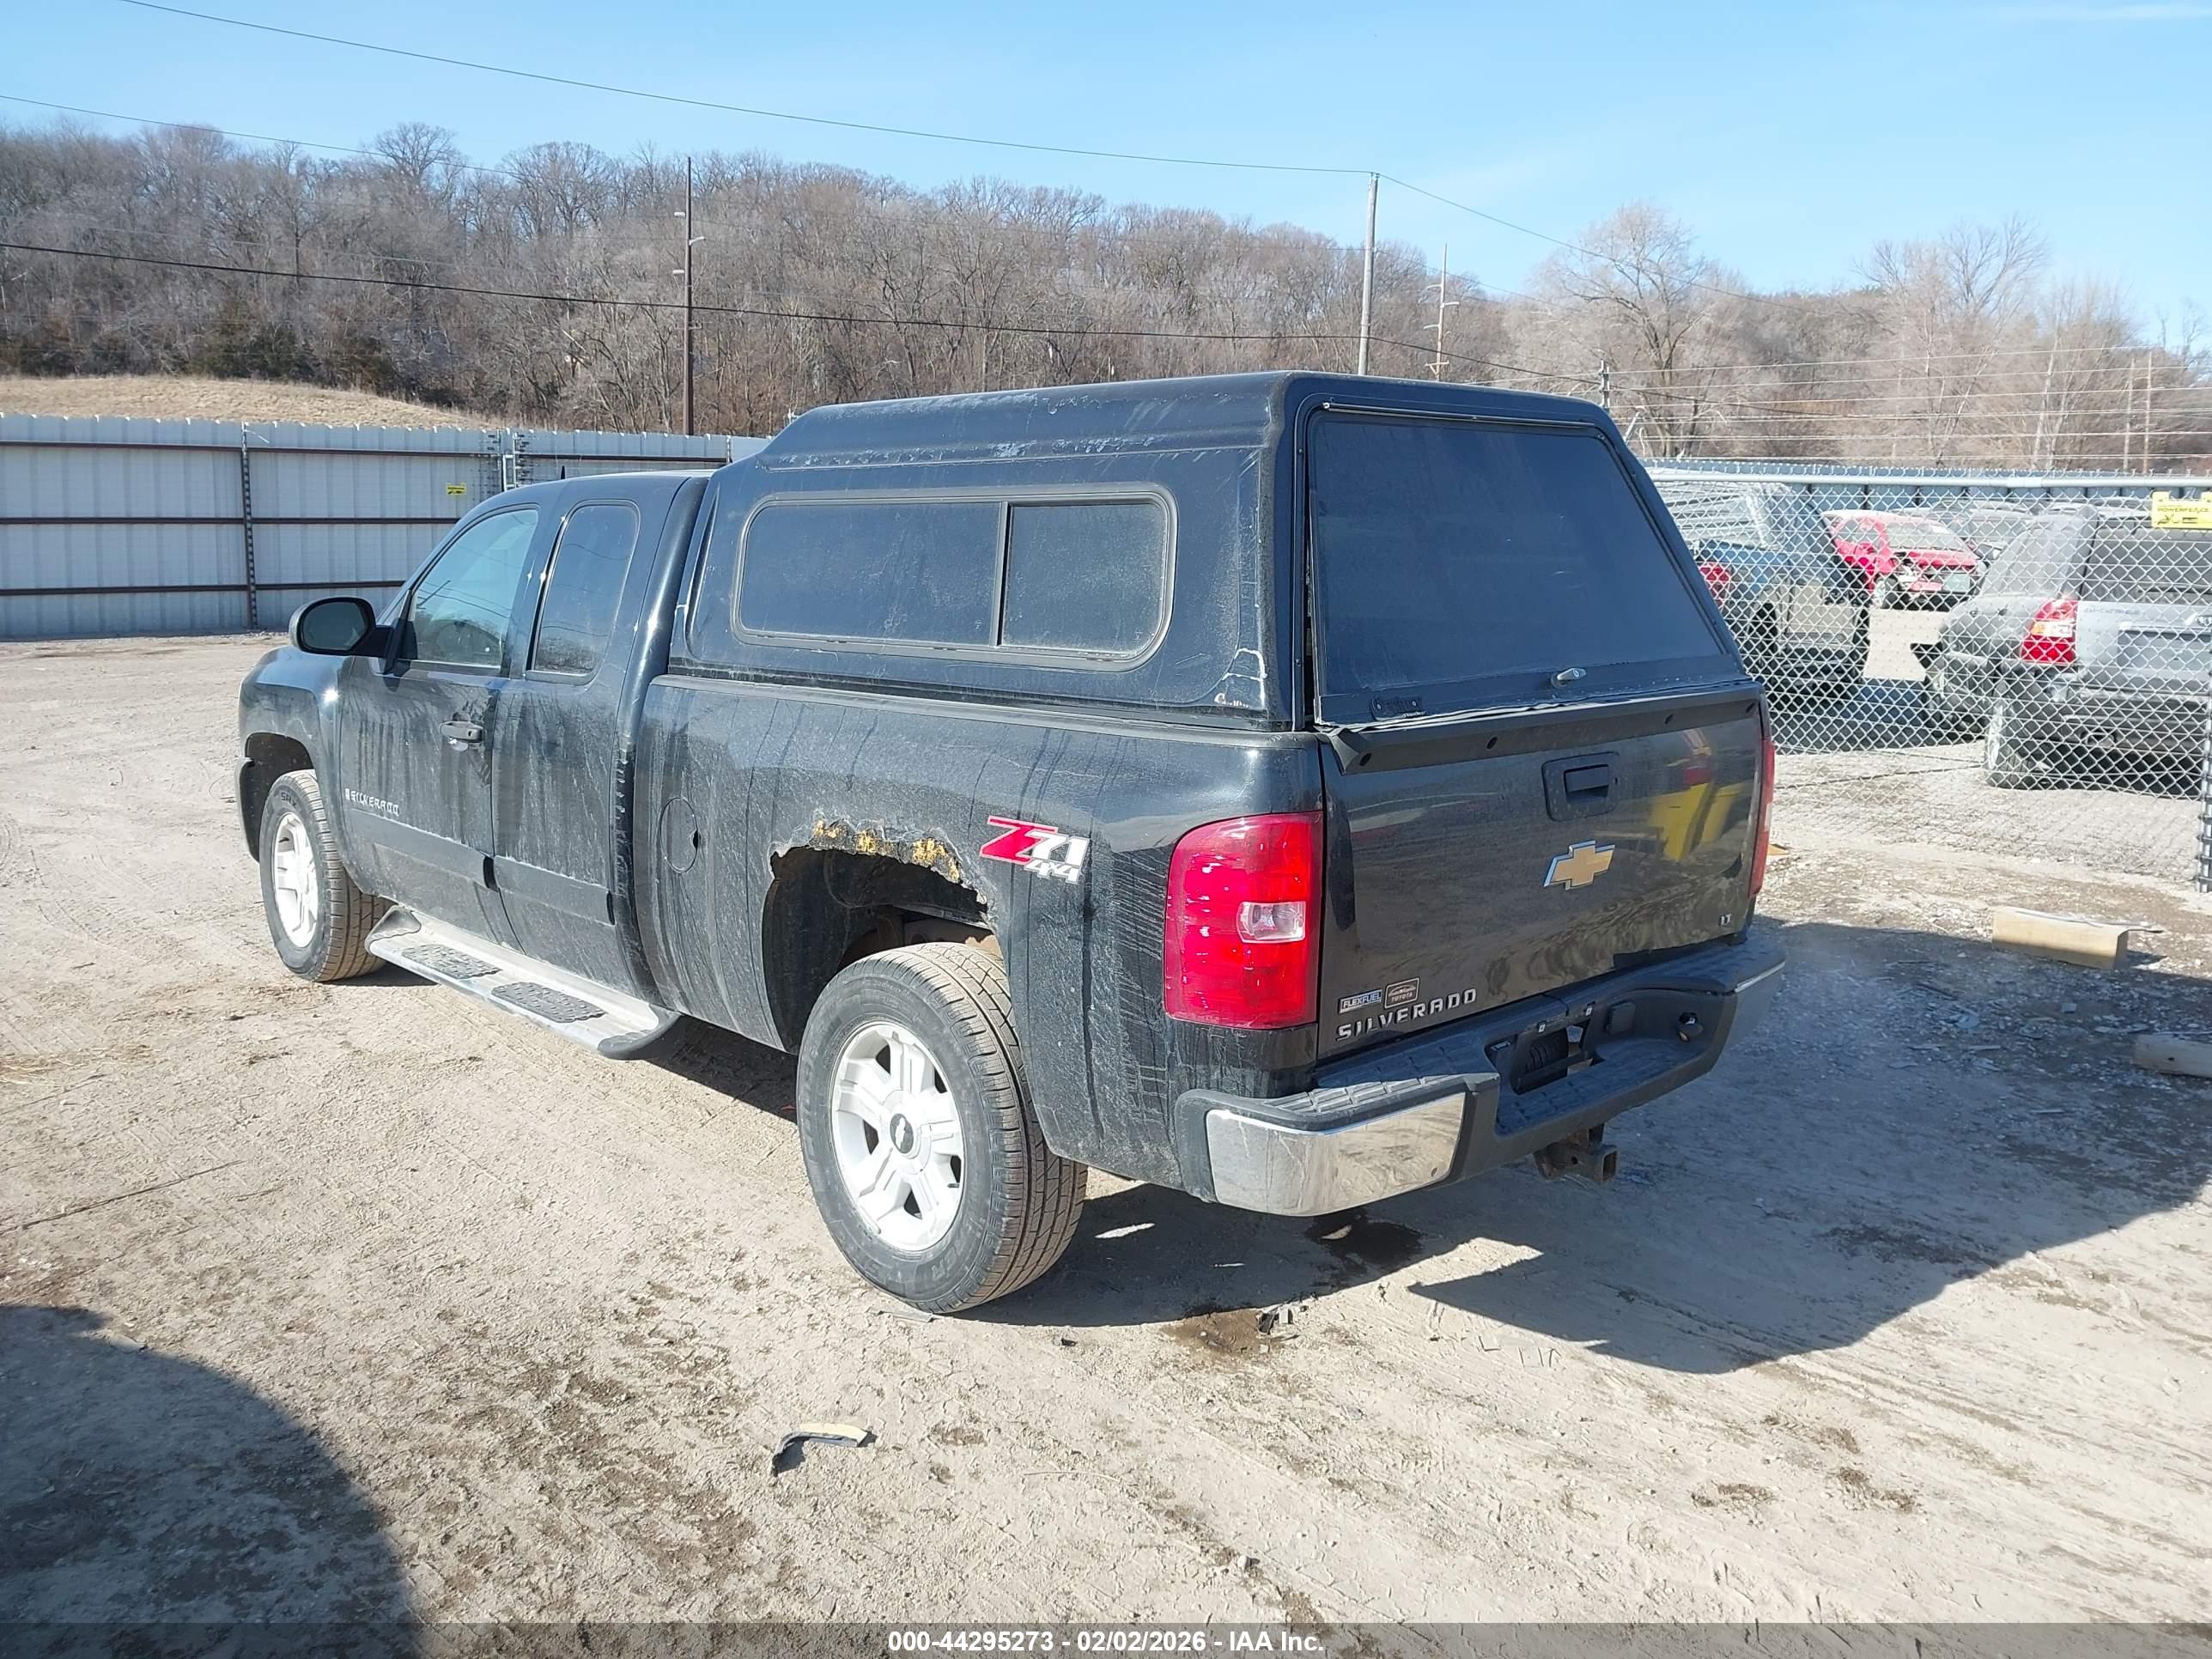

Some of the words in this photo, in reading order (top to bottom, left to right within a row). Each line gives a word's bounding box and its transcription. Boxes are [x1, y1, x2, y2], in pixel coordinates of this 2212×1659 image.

[350, 790, 399, 817] SILVERADO
[979, 815, 1091, 867] Z71
[1342, 991, 1382, 1009] FLEXFUEL
[1390, 992, 1413, 1003] TOYOTA
[1336, 988, 1478, 1042] SILVERADO
